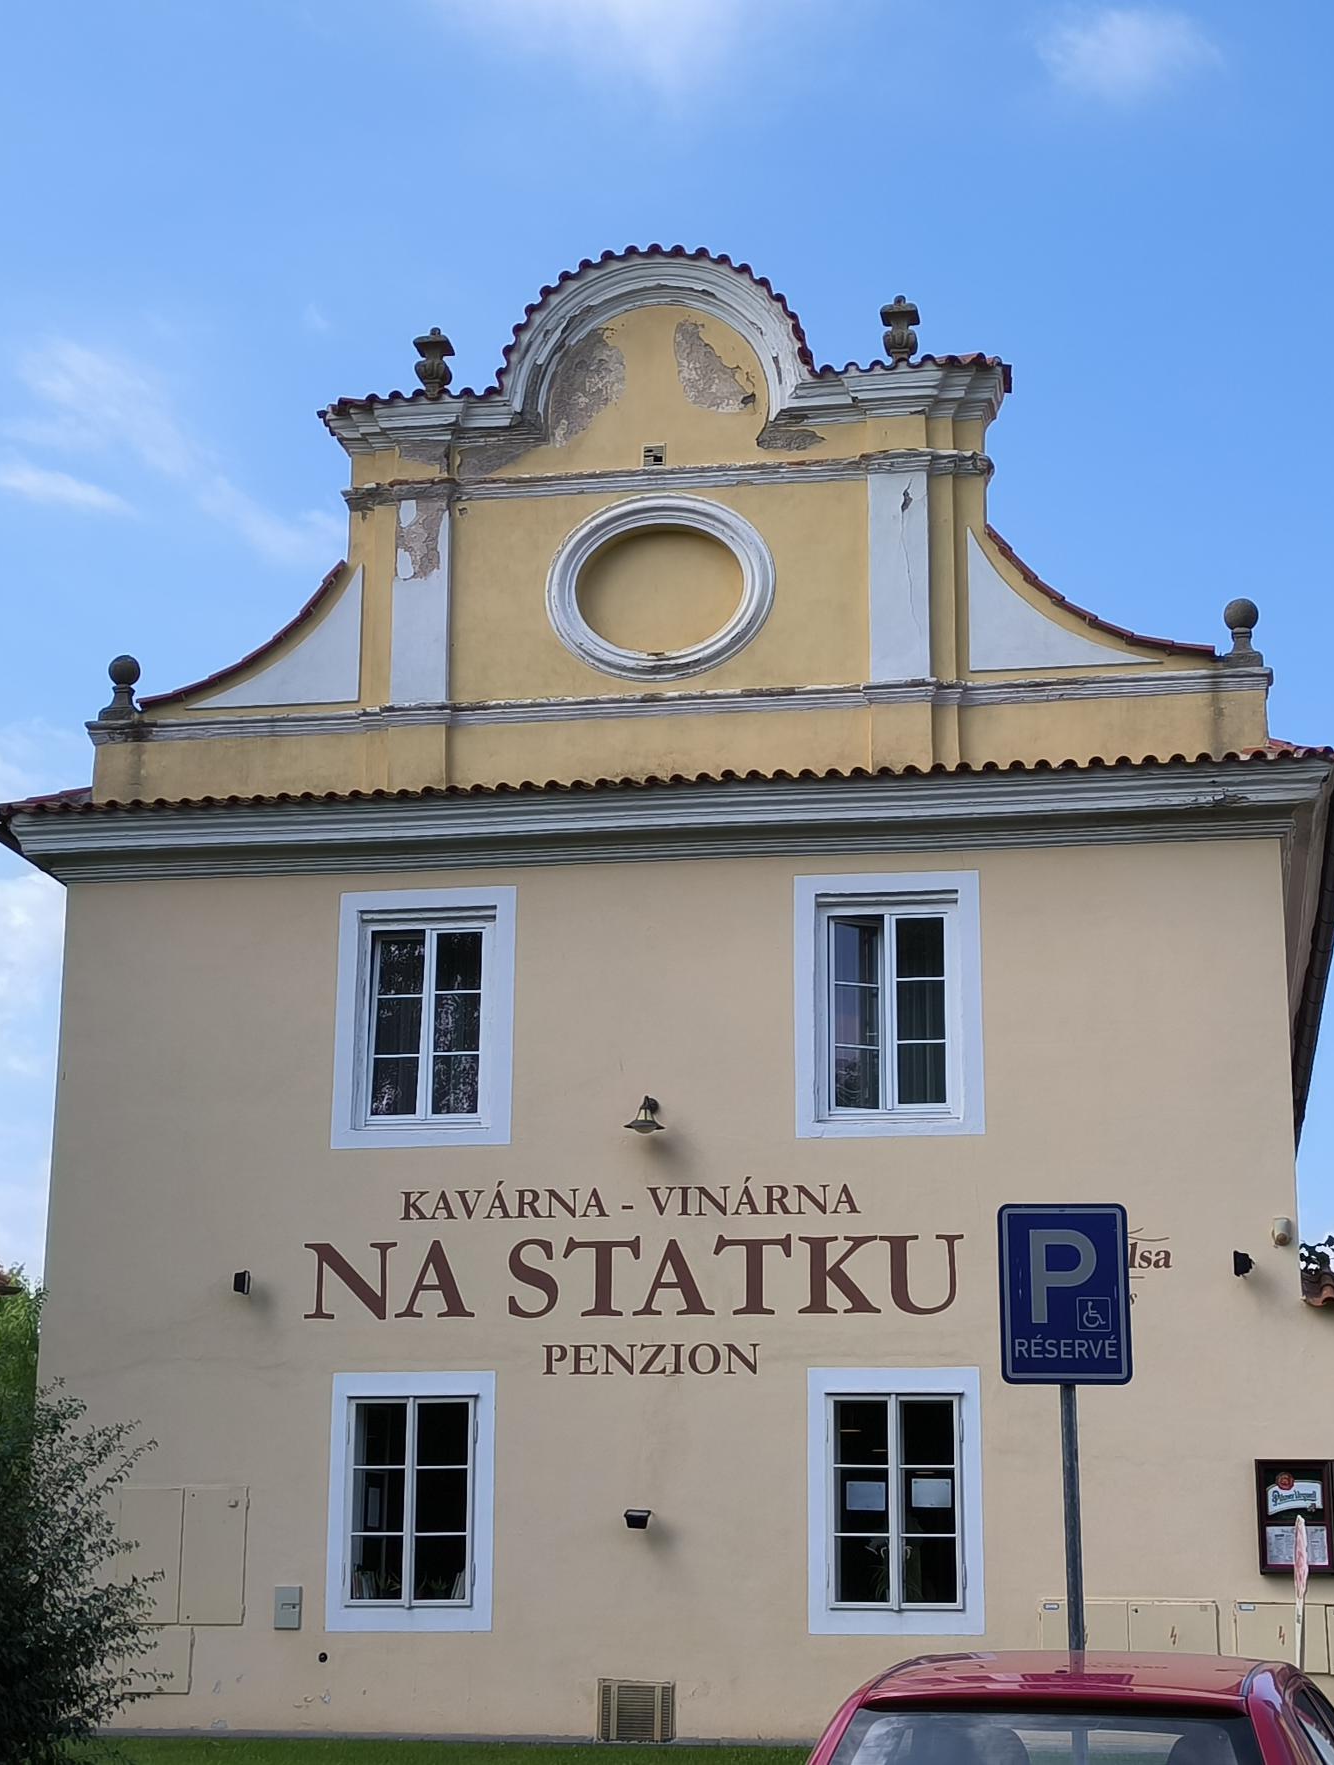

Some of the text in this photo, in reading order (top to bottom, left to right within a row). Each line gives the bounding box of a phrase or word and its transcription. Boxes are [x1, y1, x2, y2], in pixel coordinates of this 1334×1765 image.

[400, 1181, 608, 1221] KAVÁRNA
[648, 1177, 861, 1217] VINÁRNA
[303, 1234, 965, 1320] NA STATKU
[1029, 1229, 1097, 1324] P
[542, 1343, 760, 1376] PENZION
[1014, 1334, 1118, 1360] RÉSERVÉ
